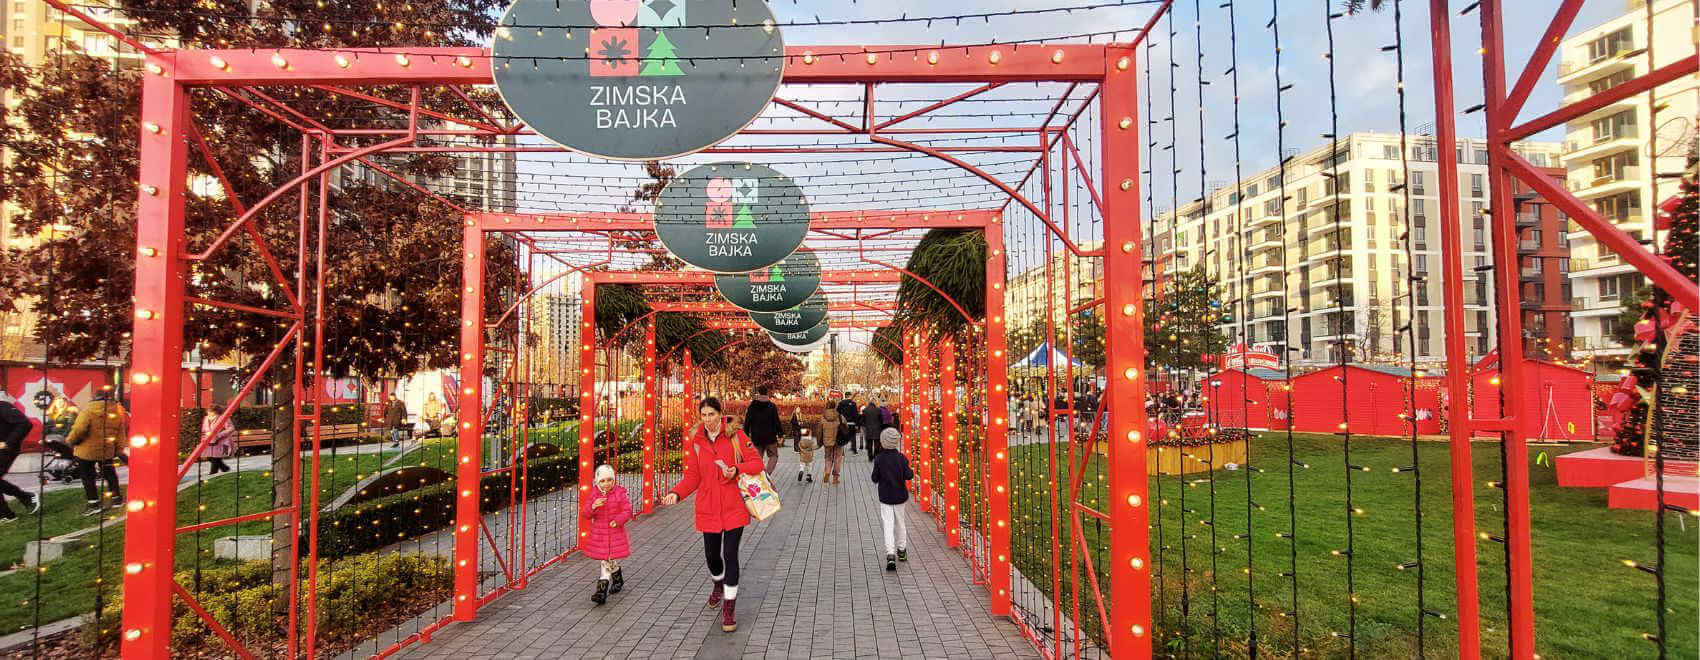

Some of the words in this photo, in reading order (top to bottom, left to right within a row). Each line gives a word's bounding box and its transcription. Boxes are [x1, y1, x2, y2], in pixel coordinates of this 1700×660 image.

[589, 85, 687, 106] ZIMSKA
[596, 108, 677, 129] BAJKA
[705, 232, 758, 245] ZIMSKA
[709, 245, 752, 257] BAJKA
[750, 284, 787, 294] ZIMSKA
[752, 293, 783, 302] BAJKA
[774, 312, 801, 320] ZIMSKA
